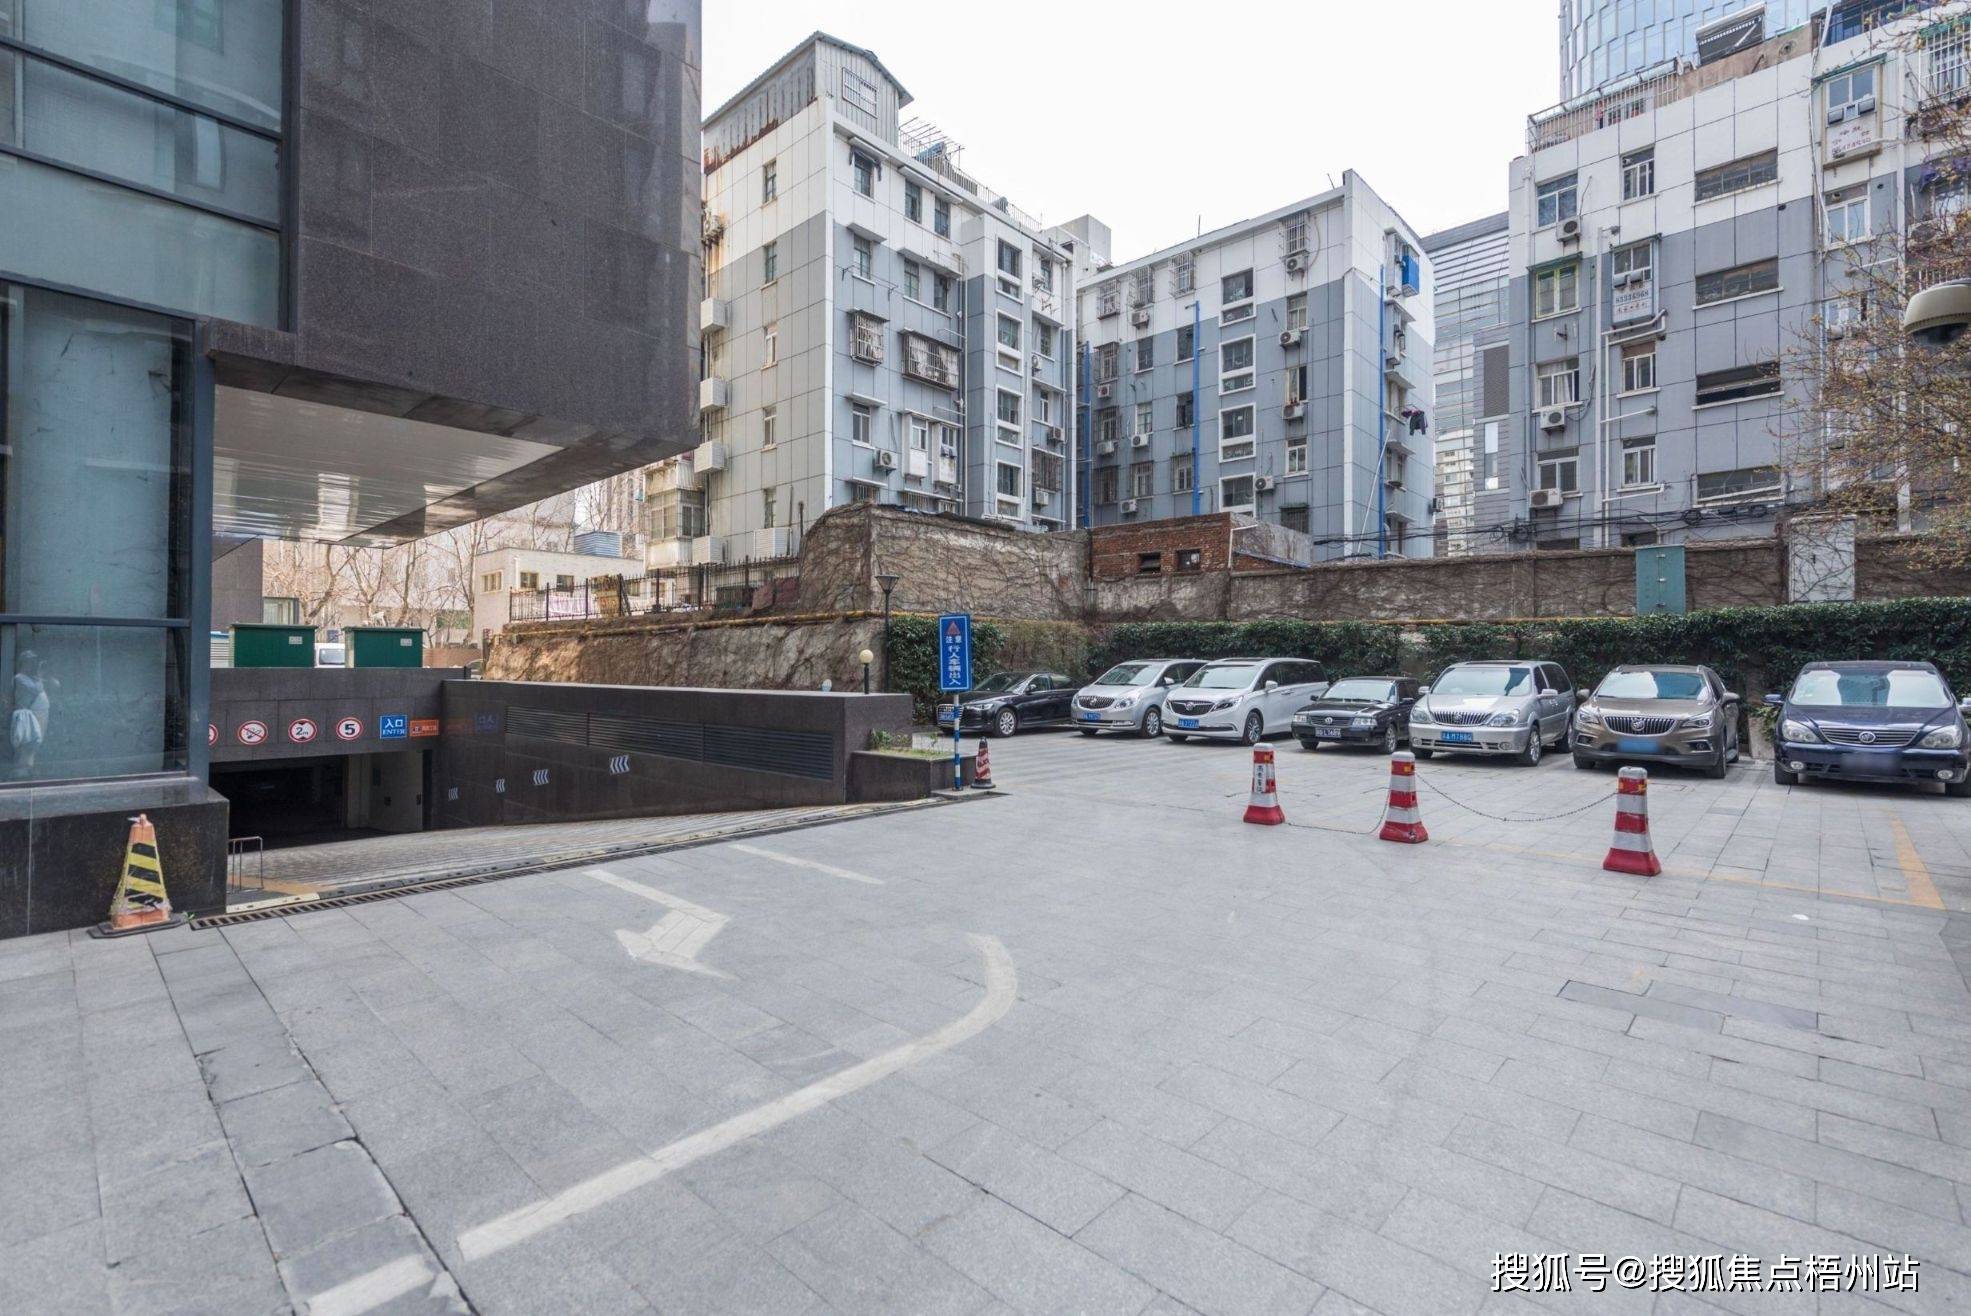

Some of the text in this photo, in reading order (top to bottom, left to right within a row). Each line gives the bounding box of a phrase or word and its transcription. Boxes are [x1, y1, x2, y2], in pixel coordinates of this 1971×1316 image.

[384, 718, 404, 729] 入口
[295, 726, 309, 736] 2m
[344, 723, 356, 736] 5
